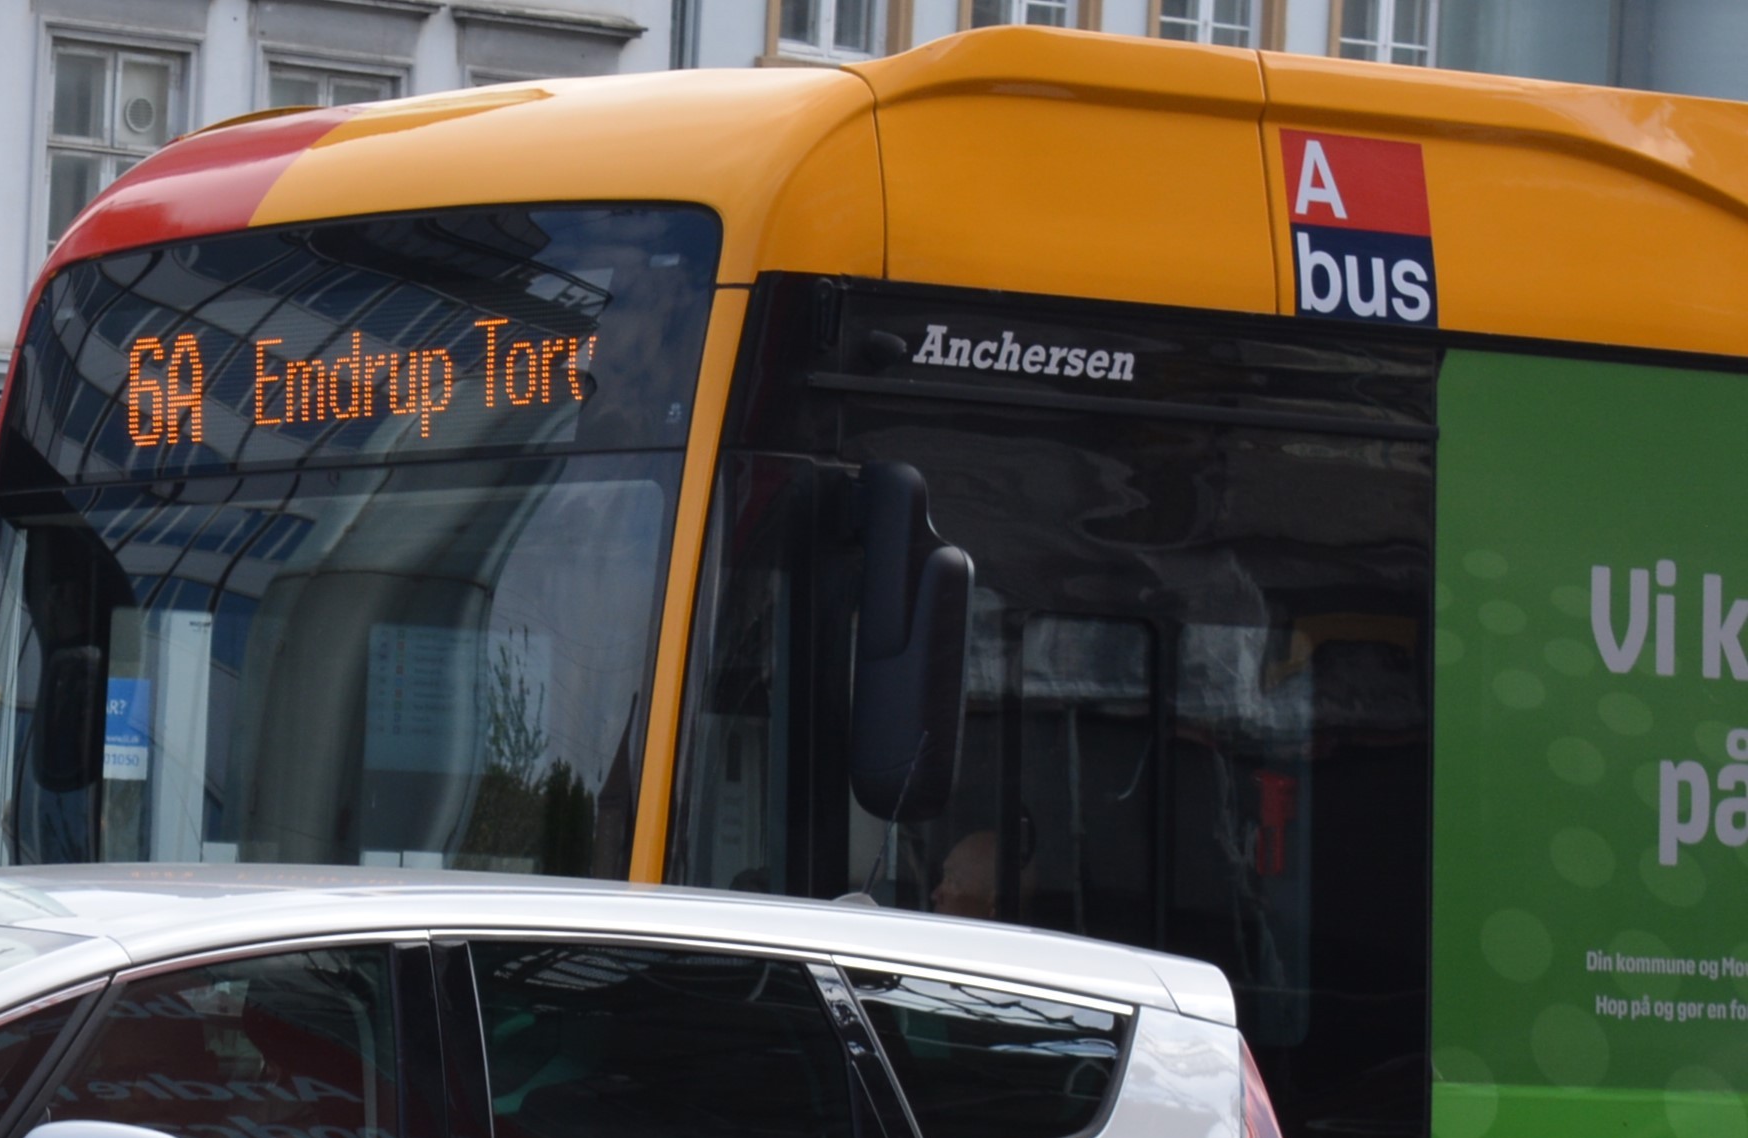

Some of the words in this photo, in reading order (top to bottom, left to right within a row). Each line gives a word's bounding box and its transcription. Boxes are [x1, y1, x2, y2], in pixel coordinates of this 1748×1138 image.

[1294, 139, 1348, 220] A
[1296, 231, 1431, 323] bus
[128, 332, 204, 447] 6A
[254, 330, 453, 438] Emdrup
[913, 324, 1136, 382] Anchersen
[1590, 558, 1677, 677] Vi
[1586, 950, 1612, 972] Din
[1616, 952, 1696, 975] kommune
[1698, 959, 1718, 979] og
[1595, 994, 1628, 1020] Hop
[1631, 994, 1650, 1020] på
[1654, 1001, 1673, 1021] og
[1707, 1002, 1726, 1019] en
[1730, 998, 1748, 1020] fo
